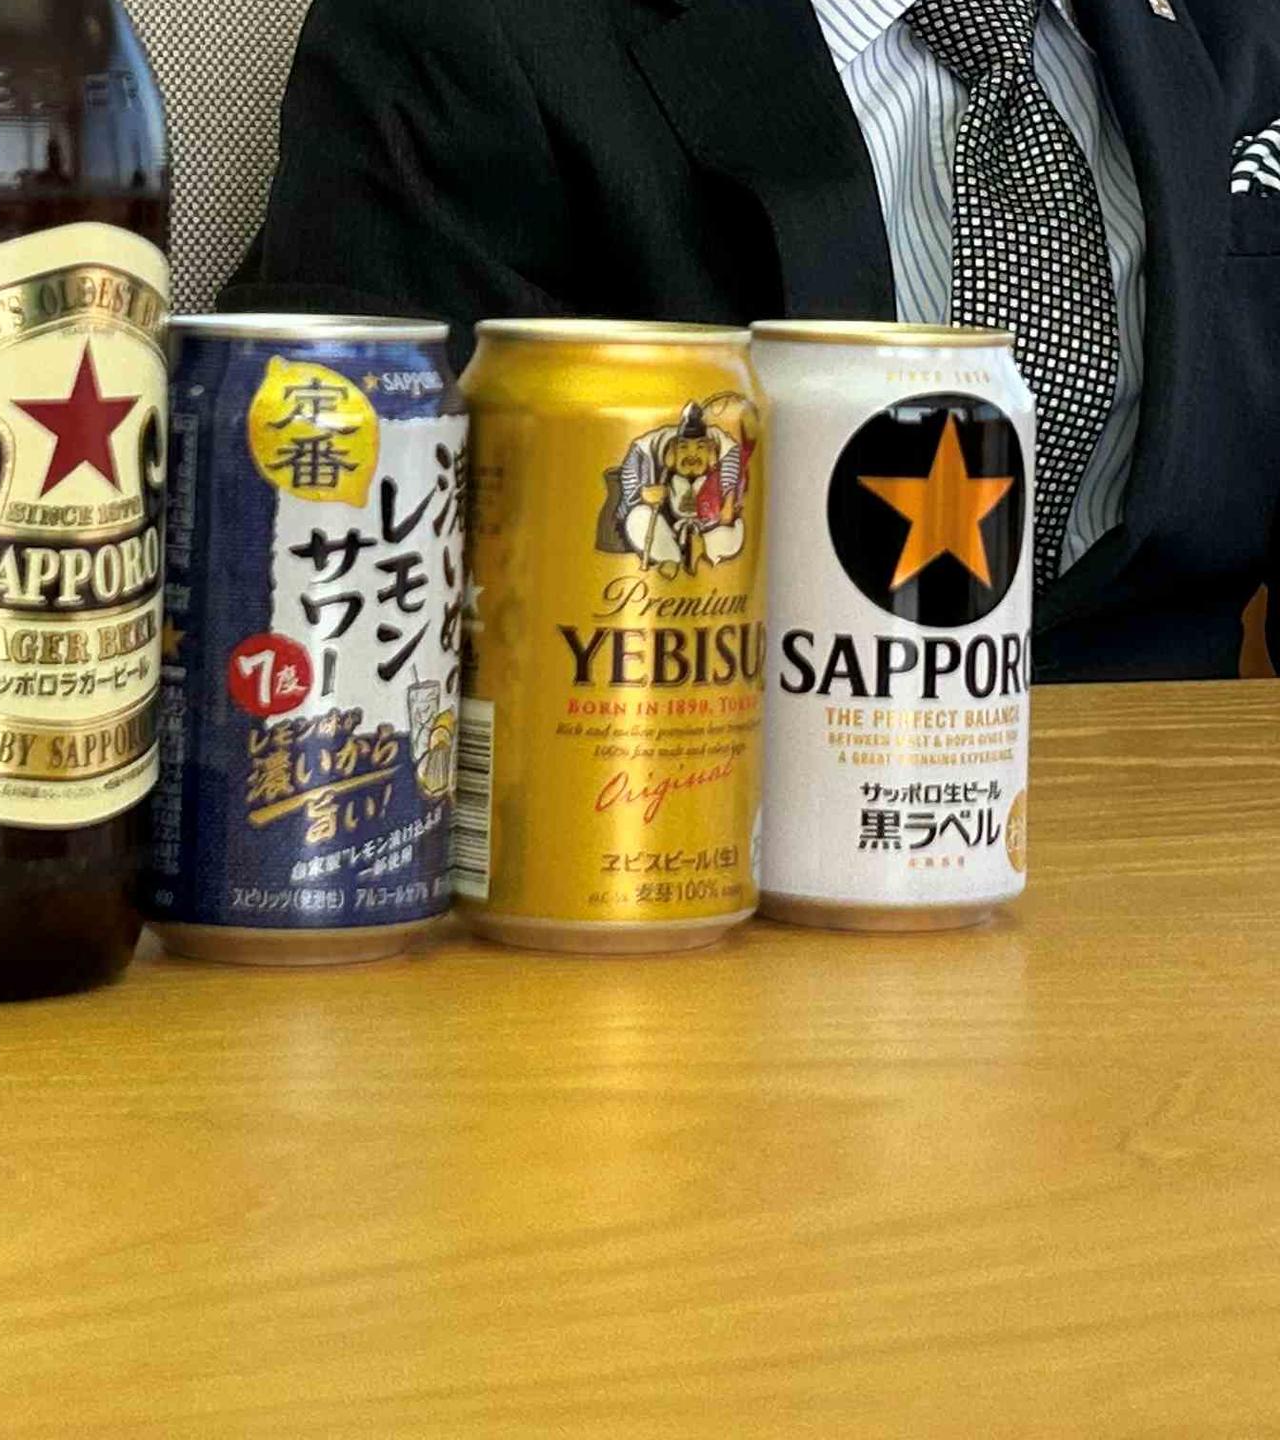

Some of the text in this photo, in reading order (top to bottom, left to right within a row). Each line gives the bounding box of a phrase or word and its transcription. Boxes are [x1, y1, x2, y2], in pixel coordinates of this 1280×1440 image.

[39, 275, 140, 318] OLDEST
[266, 376, 361, 489] 定番
[375, 474, 437, 682] レモン
[593, 574, 749, 618] Premium
[288, 526, 378, 697] サワー
[557, 621, 767, 688] YEBISU
[566, 698, 627, 716] BORN
[636, 701, 659, 715] IN
[824, 706, 863, 727] THE
[593, 758, 735, 825] Original
[859, 779, 1002, 804] サッポロ生ビール
[857, 807, 1002, 850] 黒ラベル
